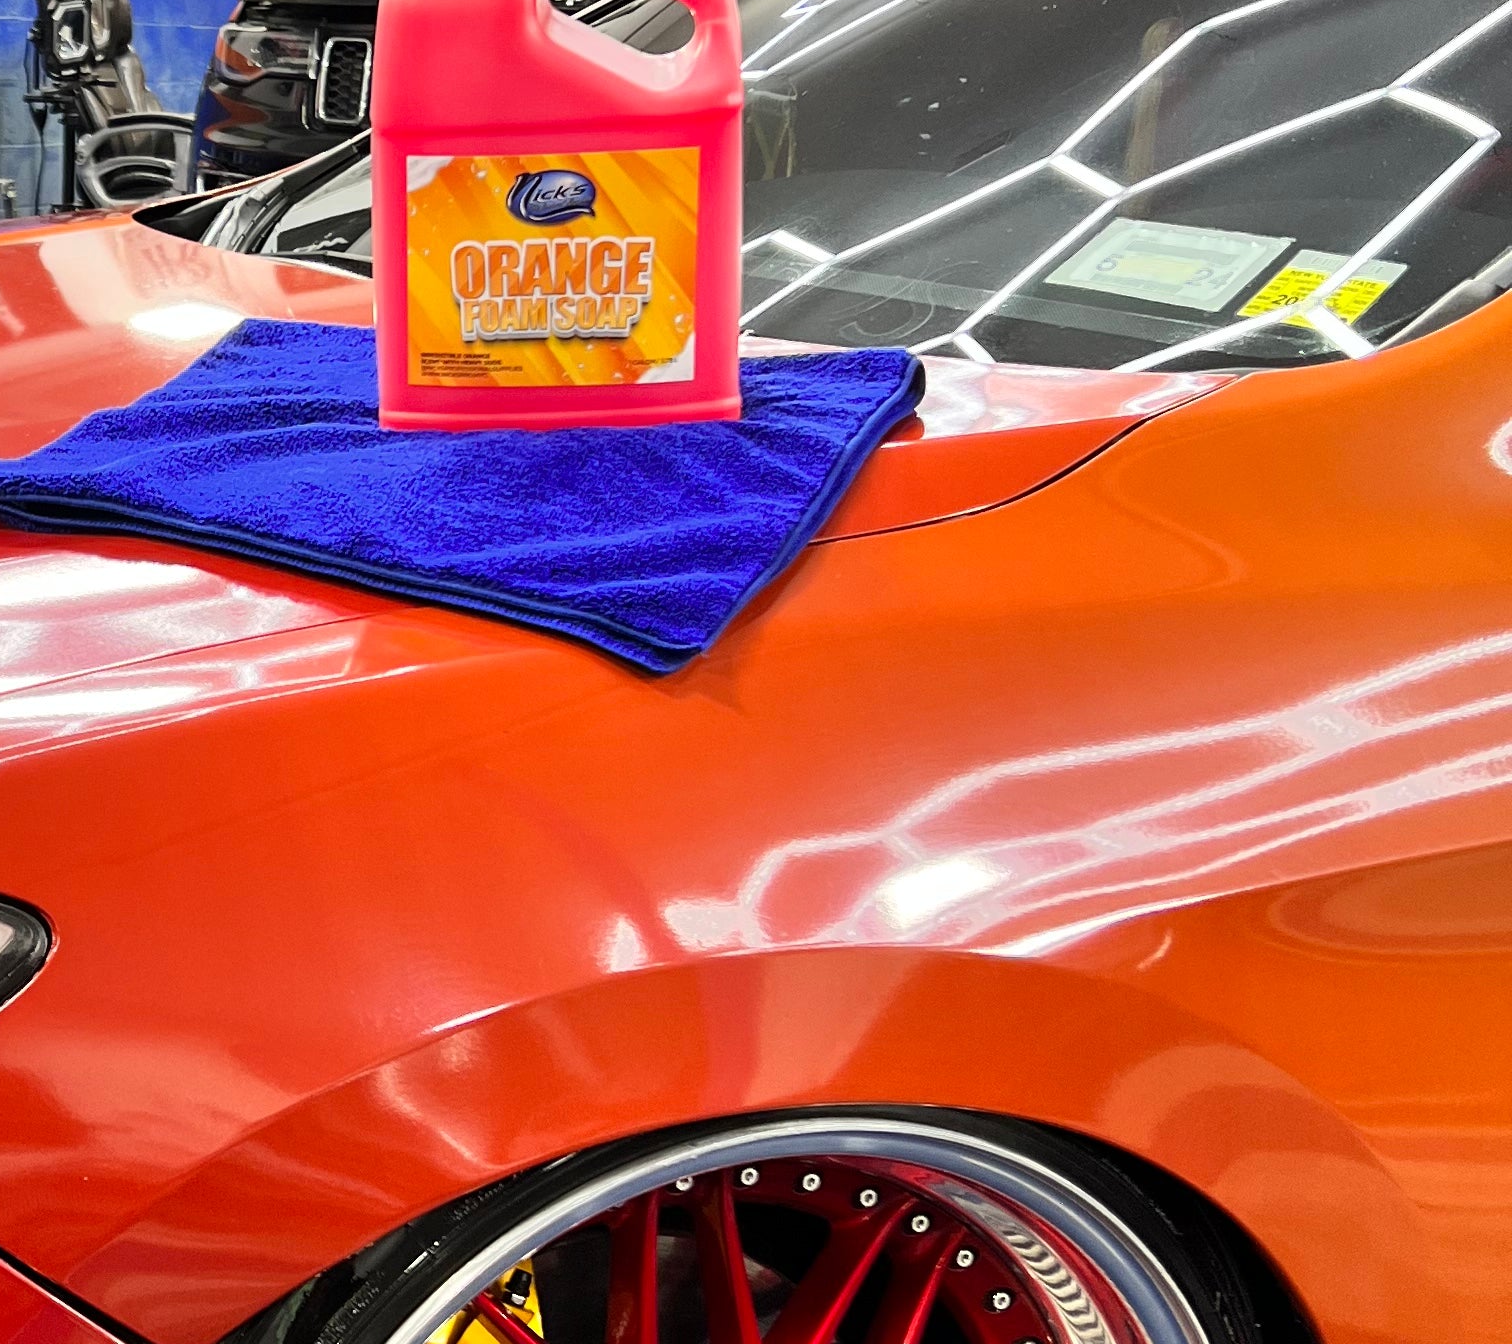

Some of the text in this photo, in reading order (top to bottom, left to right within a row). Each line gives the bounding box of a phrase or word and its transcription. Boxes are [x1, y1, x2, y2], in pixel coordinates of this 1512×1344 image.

[451, 236, 655, 300] ORANGE
[462, 294, 640, 340] FOAM SOAP
